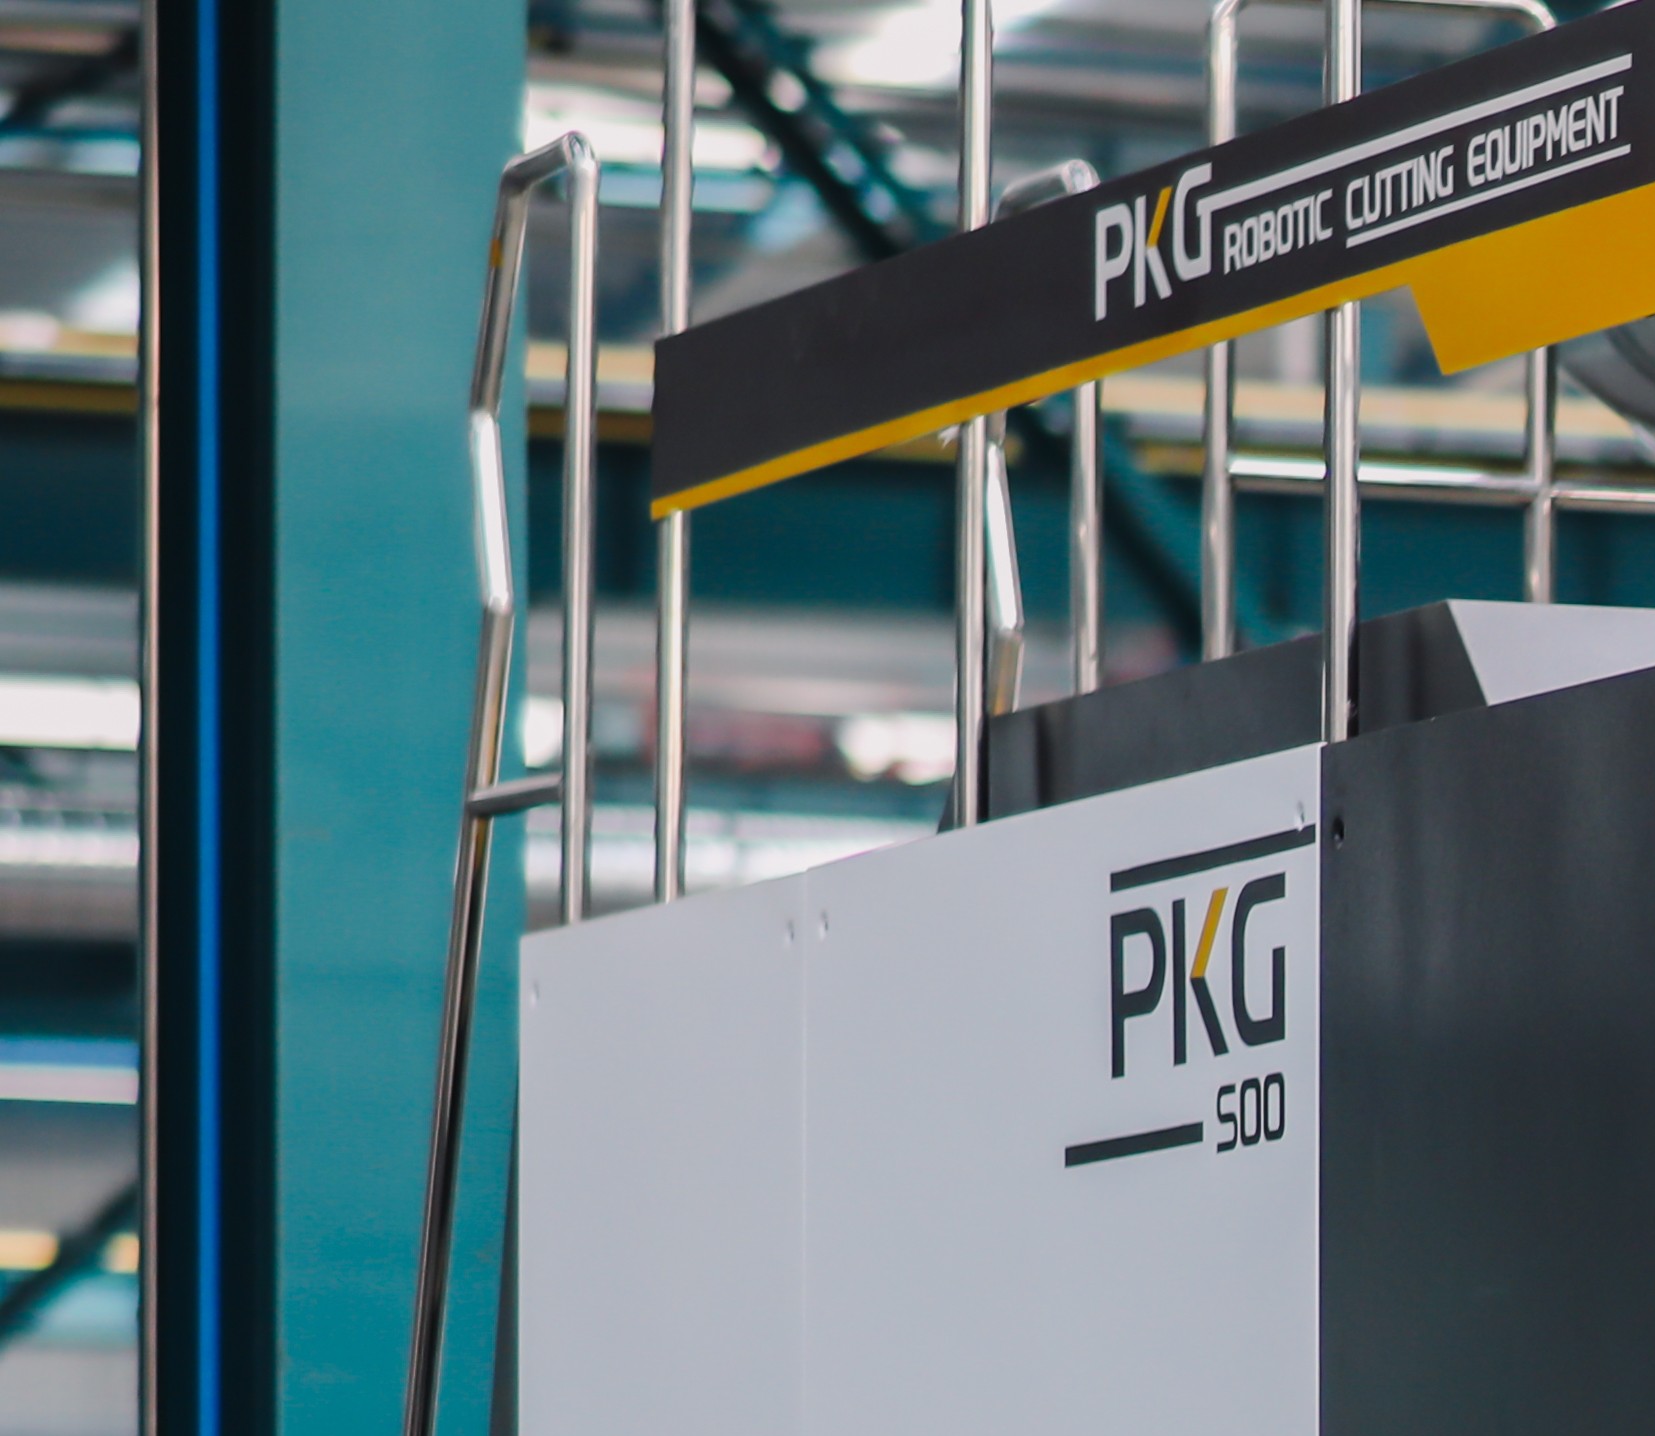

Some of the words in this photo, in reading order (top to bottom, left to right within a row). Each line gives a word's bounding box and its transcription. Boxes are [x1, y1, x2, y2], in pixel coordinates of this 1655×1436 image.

[1095, 162, 1212, 322] PKG
[1223, 188, 1334, 275] ROBOTIC
[1345, 145, 1455, 230] CUTTING
[1466, 85, 1625, 188] EQUIPMENT
[1111, 872, 1287, 1080] PKG
